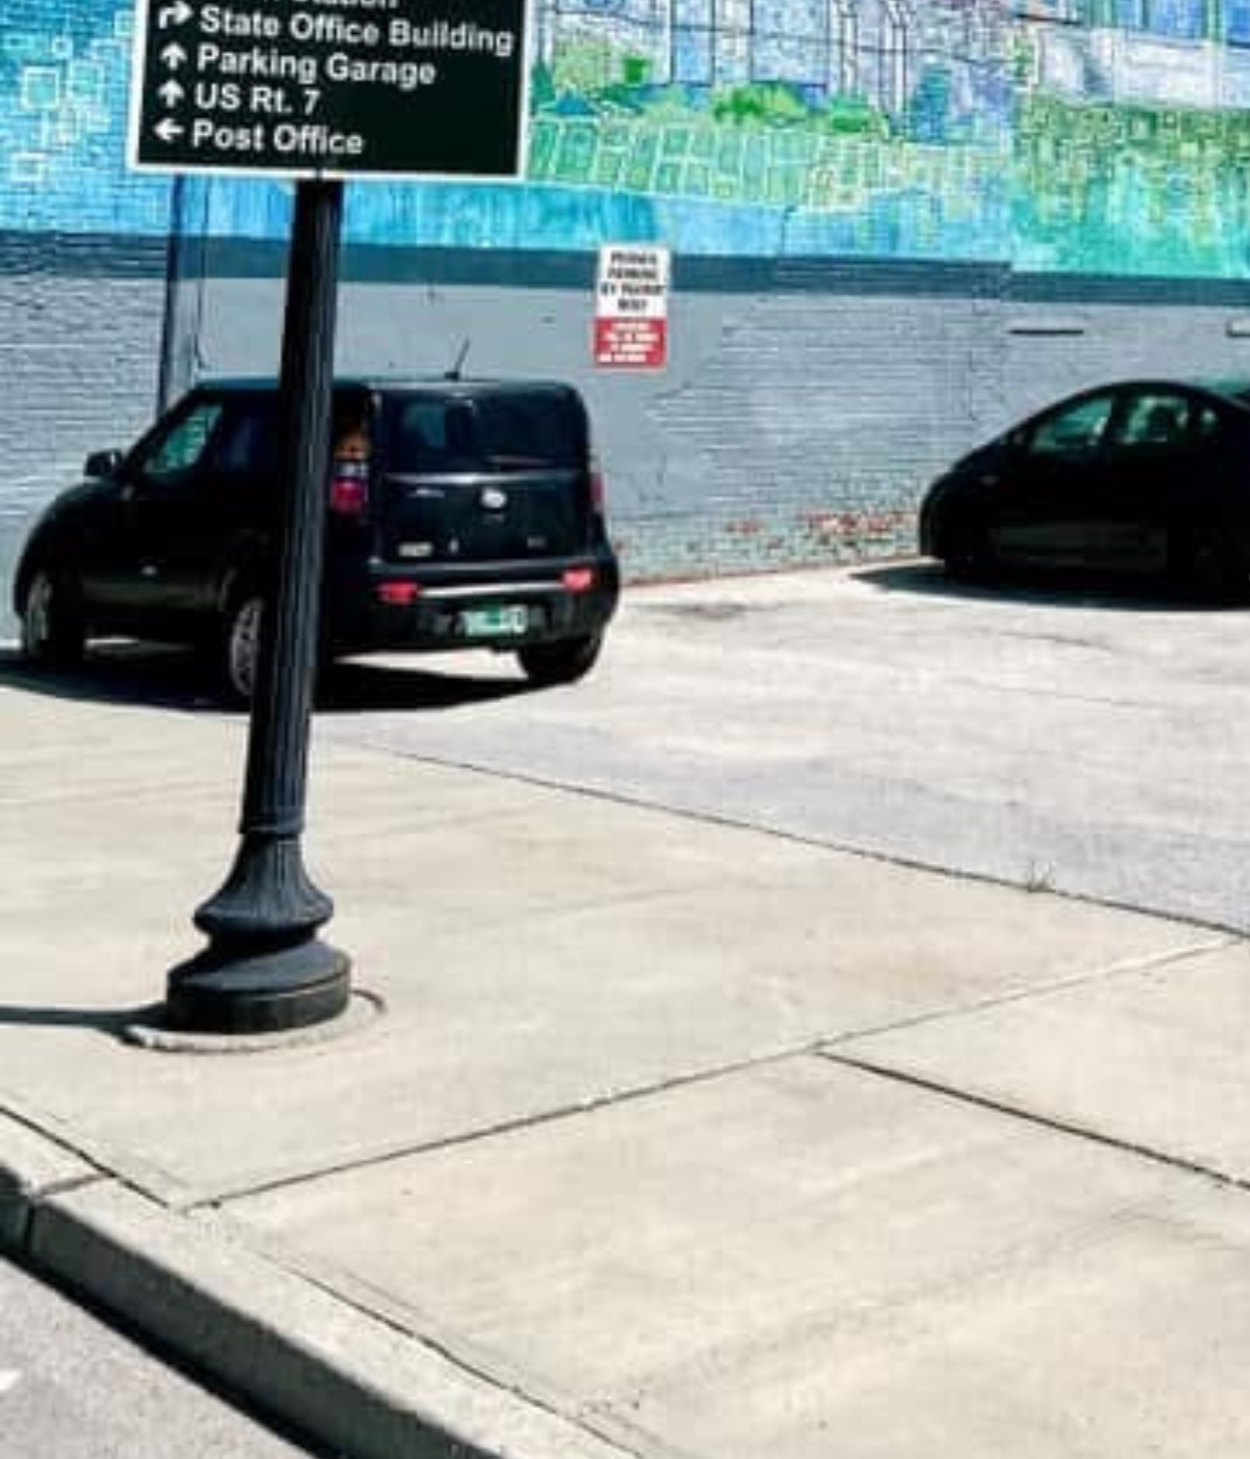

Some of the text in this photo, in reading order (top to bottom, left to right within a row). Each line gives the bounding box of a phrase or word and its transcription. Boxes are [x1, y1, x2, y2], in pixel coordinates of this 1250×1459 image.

[200, 5, 513, 57] State Office Building
[198, 43, 435, 90] Parking Garage
[196, 83, 320, 114] US Rt. 7
[193, 119, 363, 154] Post Office
